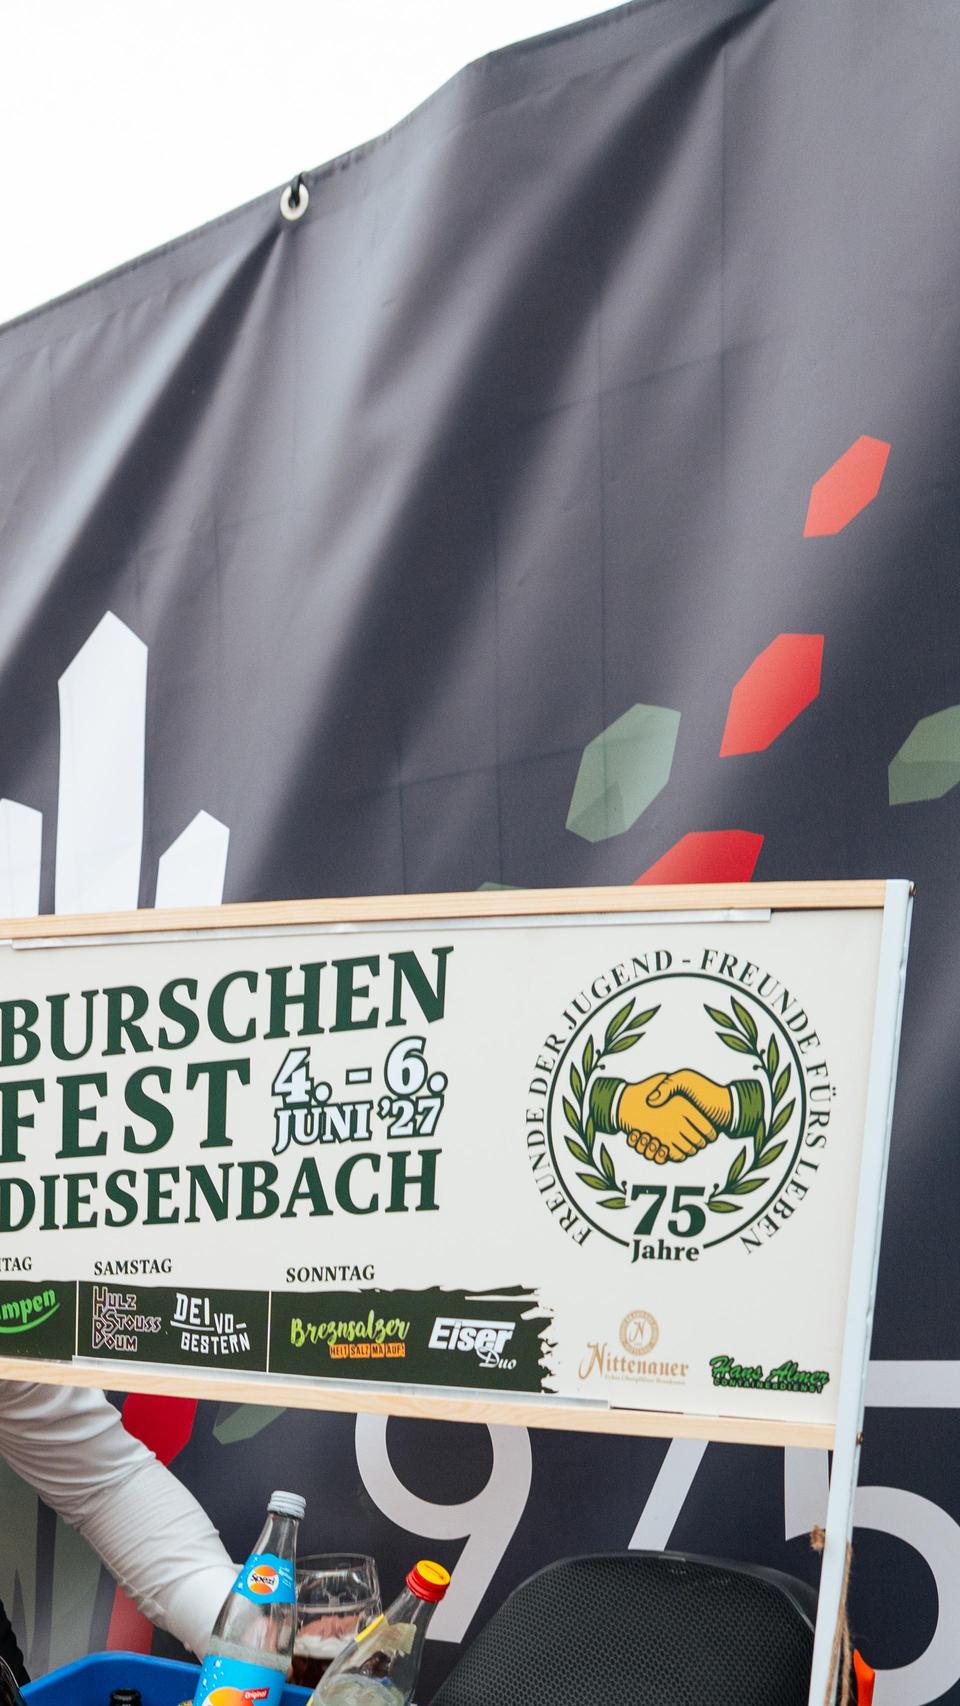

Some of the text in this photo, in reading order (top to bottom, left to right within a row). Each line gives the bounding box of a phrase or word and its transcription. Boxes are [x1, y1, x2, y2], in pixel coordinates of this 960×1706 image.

[560, 949, 673, 1031] JUGEND
[699, 948, 821, 1055] FREUNDE
[271, 1046, 333, 1106] 4.
[383, 1035, 449, 1097] 6.
[528, 1032, 567, 1097] DER
[804, 1060, 838, 1150] FÜRS
[271, 1099, 374, 1156] JUNI
[525, 1106, 592, 1247] FREUNDE
[630, 1184, 707, 1238] 75
[739, 1157, 820, 1255] LEBEN
[94, 1258, 173, 1276] SAMSTAG
[631, 1237, 700, 1264] Jahre
[285, 1264, 376, 1283] SONNTAG
[180, 1331, 251, 1355] GESTERN
[290, 1308, 411, 1348] Breznsalzer
[428, 1316, 516, 1353] Eiser
[475, 1347, 517, 1370] Duo
[578, 1342, 689, 1381] Nittenauer
[709, 1354, 763, 1380] Hans
[768, 1359, 831, 1385] Almer
[250, 1573, 276, 1586] Spezi
[244, 1689, 267, 1700] Original
